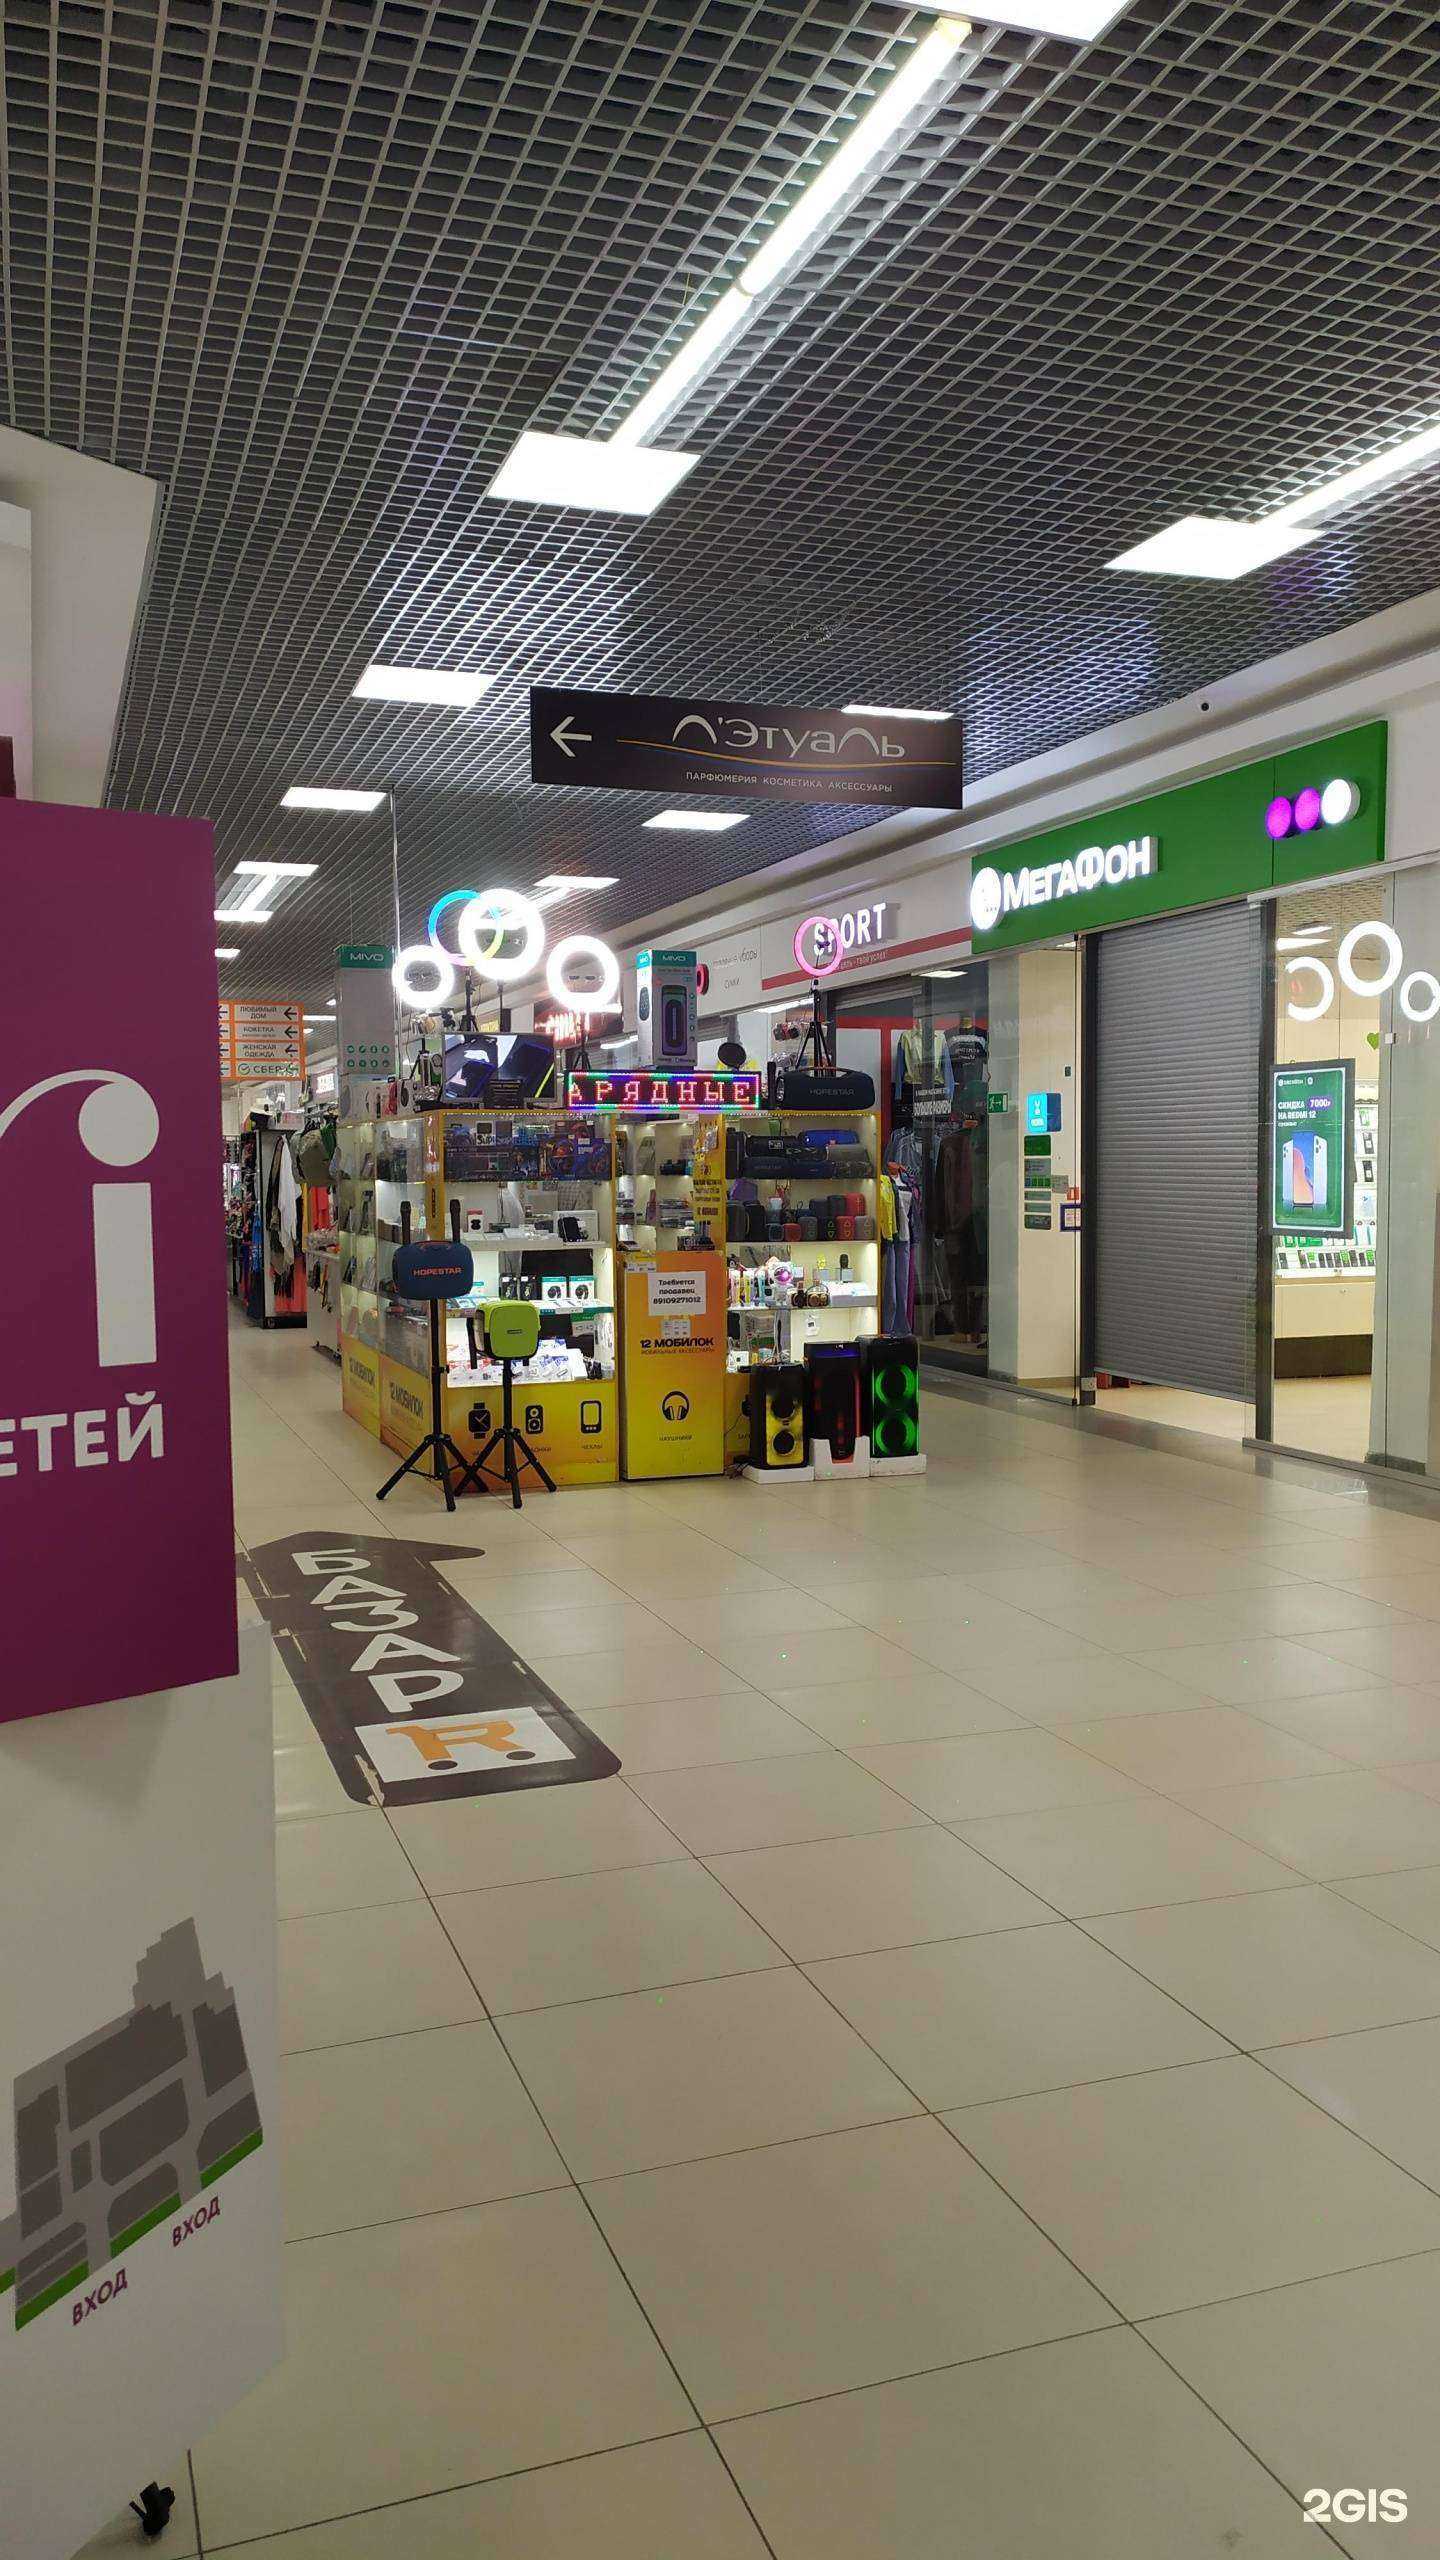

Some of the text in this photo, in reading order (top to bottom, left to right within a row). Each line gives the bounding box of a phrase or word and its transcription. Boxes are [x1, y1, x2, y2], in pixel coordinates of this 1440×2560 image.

[686, 772, 893, 792] ПАРФЮМЕРИЯ КОСМЕТИКА АКСЕССУАРЫ
[1003, 836, 1153, 911] МЕГАФОН
[350, 953, 384, 961] MIVO
[569, 1080, 750, 1103] АРЯДНЫЕ
[413, 1267, 462, 1276] HOPESTAR
[640, 1337, 714, 1348] 12 МОБИЛОК
[291, 1548, 464, 1713] БАЗАР
[172, 2196, 221, 2247] ВХОД
[72, 2268, 128, 2326] ВХОД
